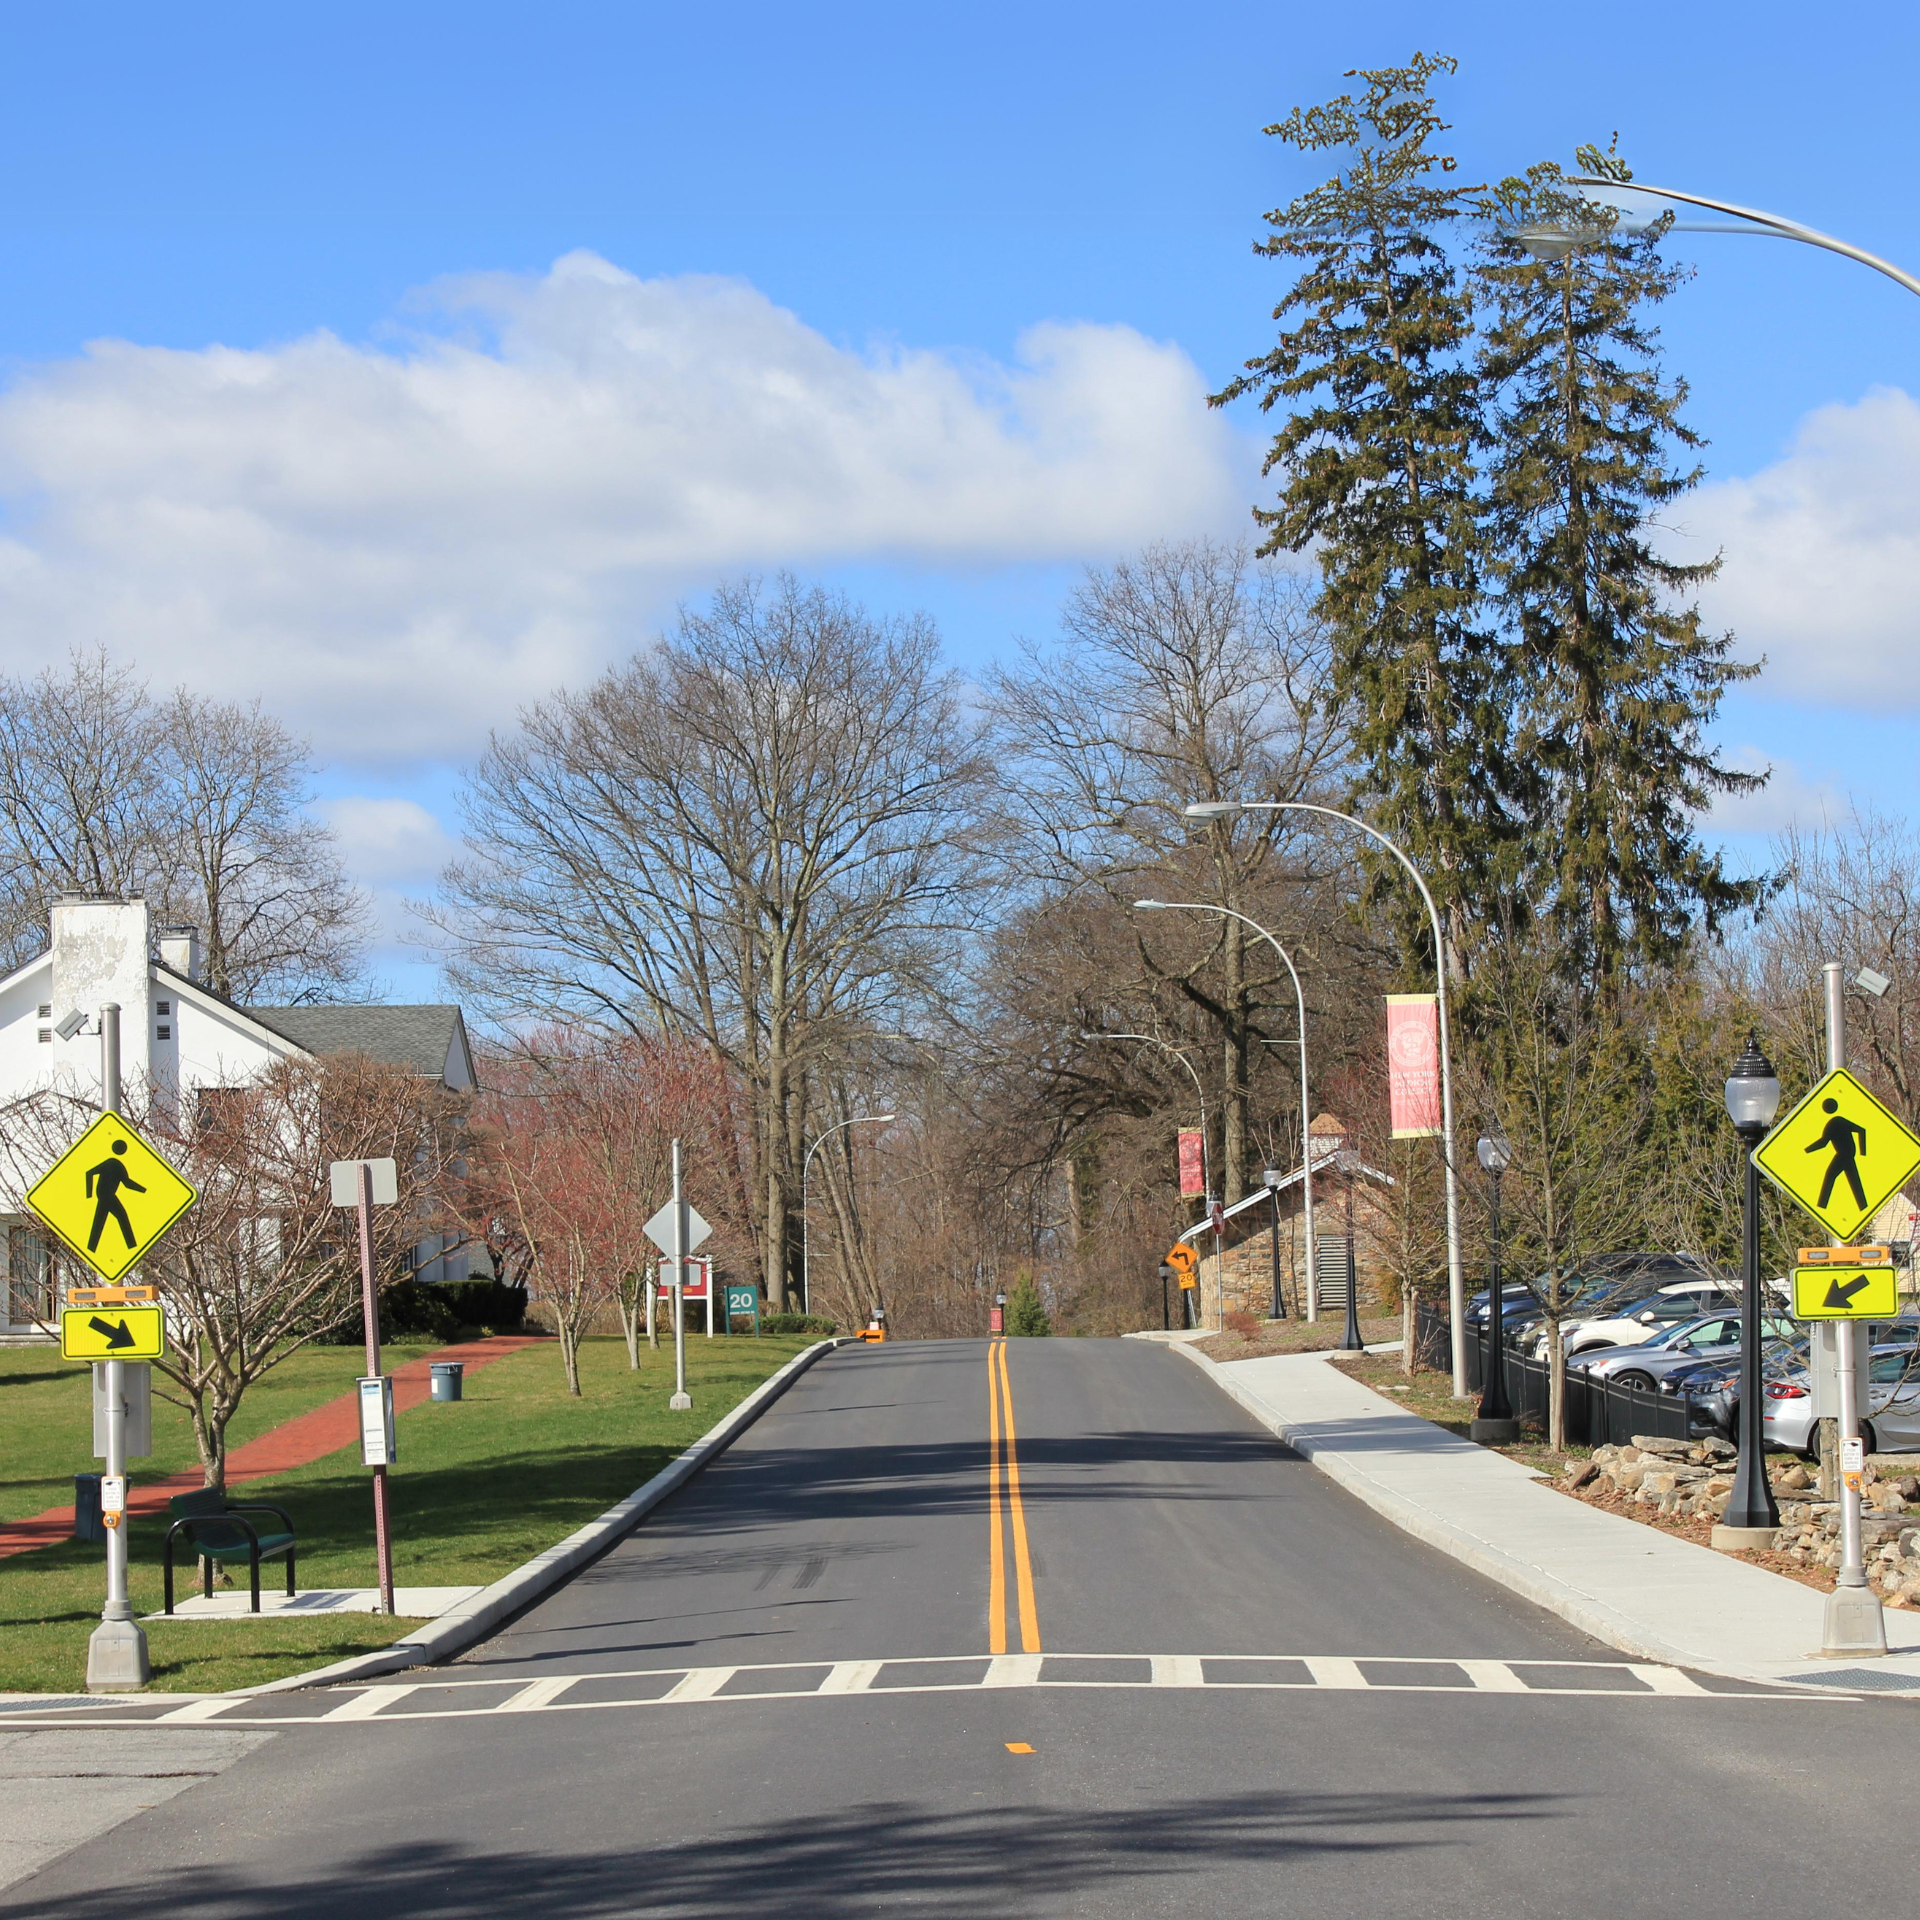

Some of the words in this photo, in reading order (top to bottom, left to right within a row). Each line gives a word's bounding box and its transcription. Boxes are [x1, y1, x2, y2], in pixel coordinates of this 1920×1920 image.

[1390, 1071, 1410, 1079] NEW
[1412, 1070, 1436, 1078] YORK
[1180, 1274, 1193, 1283] 20
[729, 1293, 753, 1308] 20
